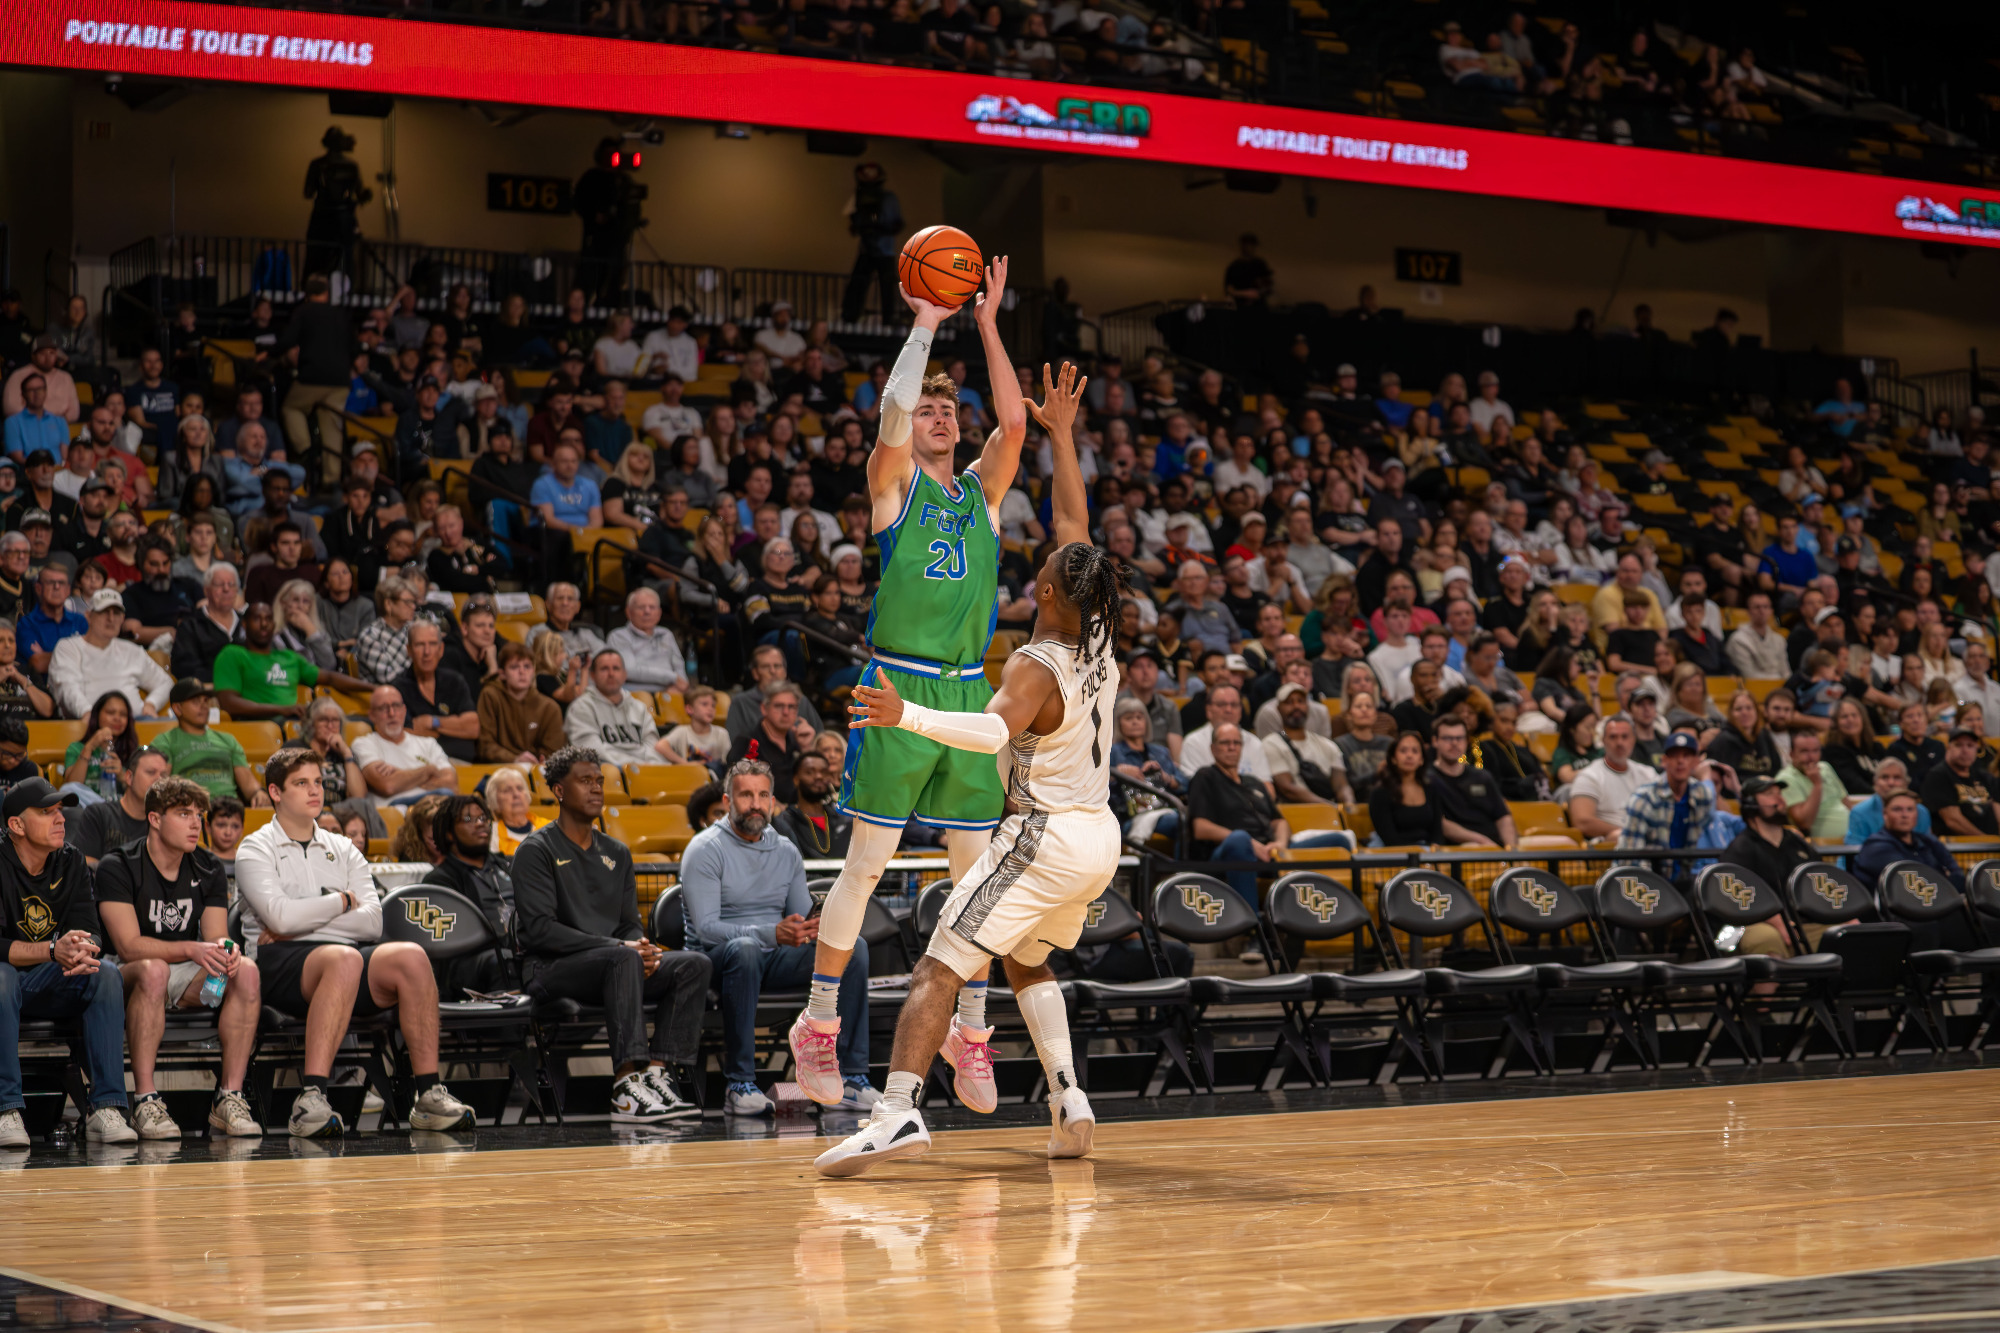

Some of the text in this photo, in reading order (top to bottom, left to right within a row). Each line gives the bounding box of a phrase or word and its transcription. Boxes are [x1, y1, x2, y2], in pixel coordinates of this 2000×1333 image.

[65, 18, 374, 66] PORTABLE TOILET RENTALS
[1237, 126, 1469, 171] PORTABLE TOILET RENTALS
[500, 179, 559, 210] 106
[953, 257, 983, 278] ELITE
[1408, 255, 1452, 280] 107
[924, 539, 968, 580] 20
[1175, 885, 1224, 925] UCF
[1290, 884, 1338, 923] UCF
[1403, 881, 1452, 919] UCF
[1512, 878, 1558, 916] UCF
[1614, 877, 1660, 914] UCF
[1714, 873, 1756, 910] UCF
[1806, 873, 1848, 909] UCF
[1898, 871, 1938, 906] UCF
[398, 897, 456, 941] UCF
